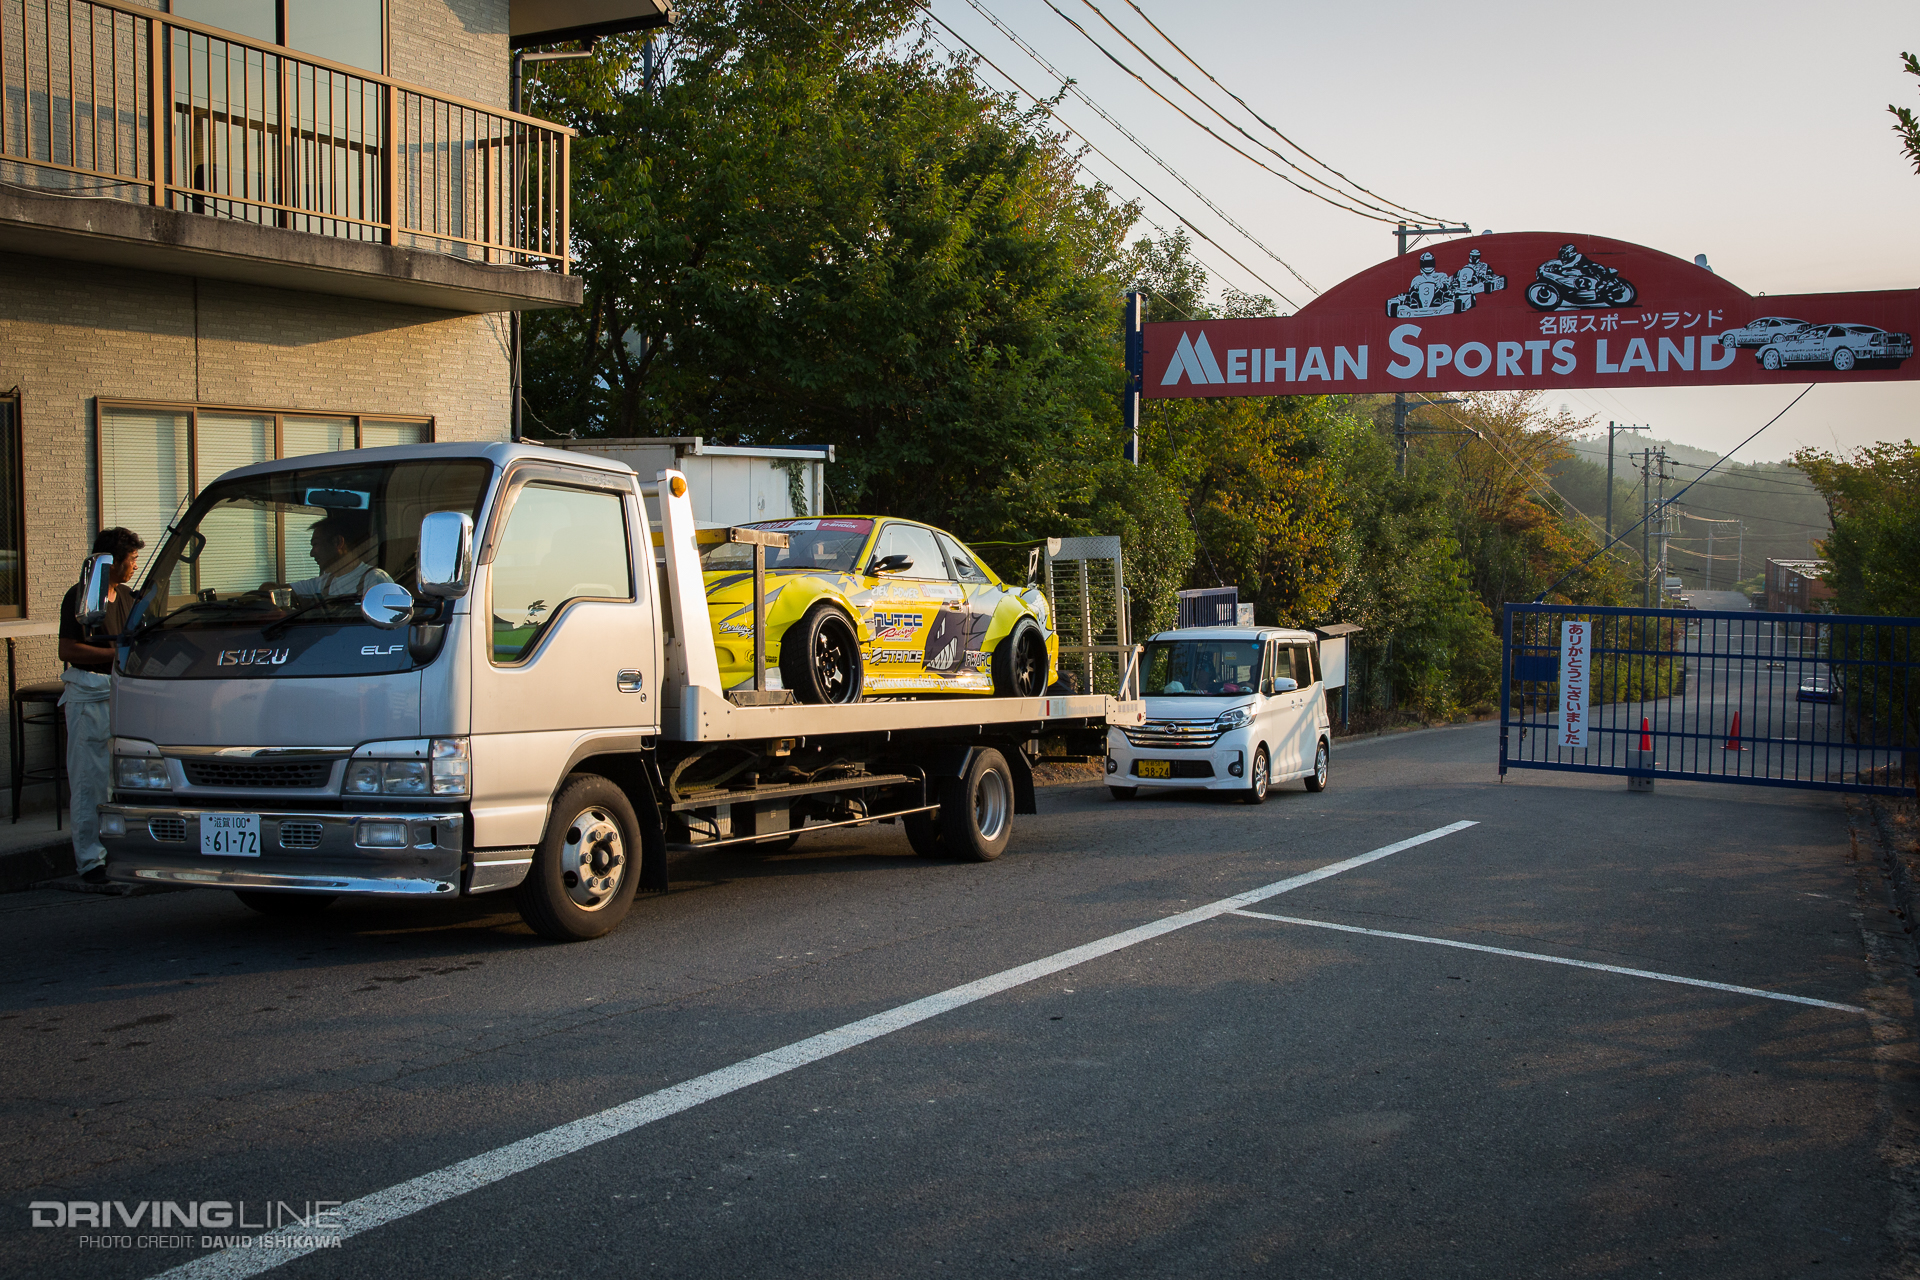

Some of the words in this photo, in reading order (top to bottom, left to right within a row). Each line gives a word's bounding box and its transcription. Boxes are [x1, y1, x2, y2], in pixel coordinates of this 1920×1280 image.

[1423, 287, 1430, 296] 3
[1539, 309, 1723, 335] 名阪スポーツランド
[1160, 329, 1369, 385] MEIHAN
[1596, 335, 1737, 374] LAND
[892, 586, 919, 600] POWER
[874, 613, 923, 627] NUTEC
[877, 626, 918, 640] Racing
[360, 644, 405, 656] ELF
[880, 650, 923, 663] STANCE
[216, 648, 290, 667] ISUZU
[863, 674, 993, 691] ttp://www.ziek-power.com
[1565, 624, 1584, 745] ありがとうございました
[1144, 767, 1169, 778] 98-24
[213, 831, 257, 853] 61-72
